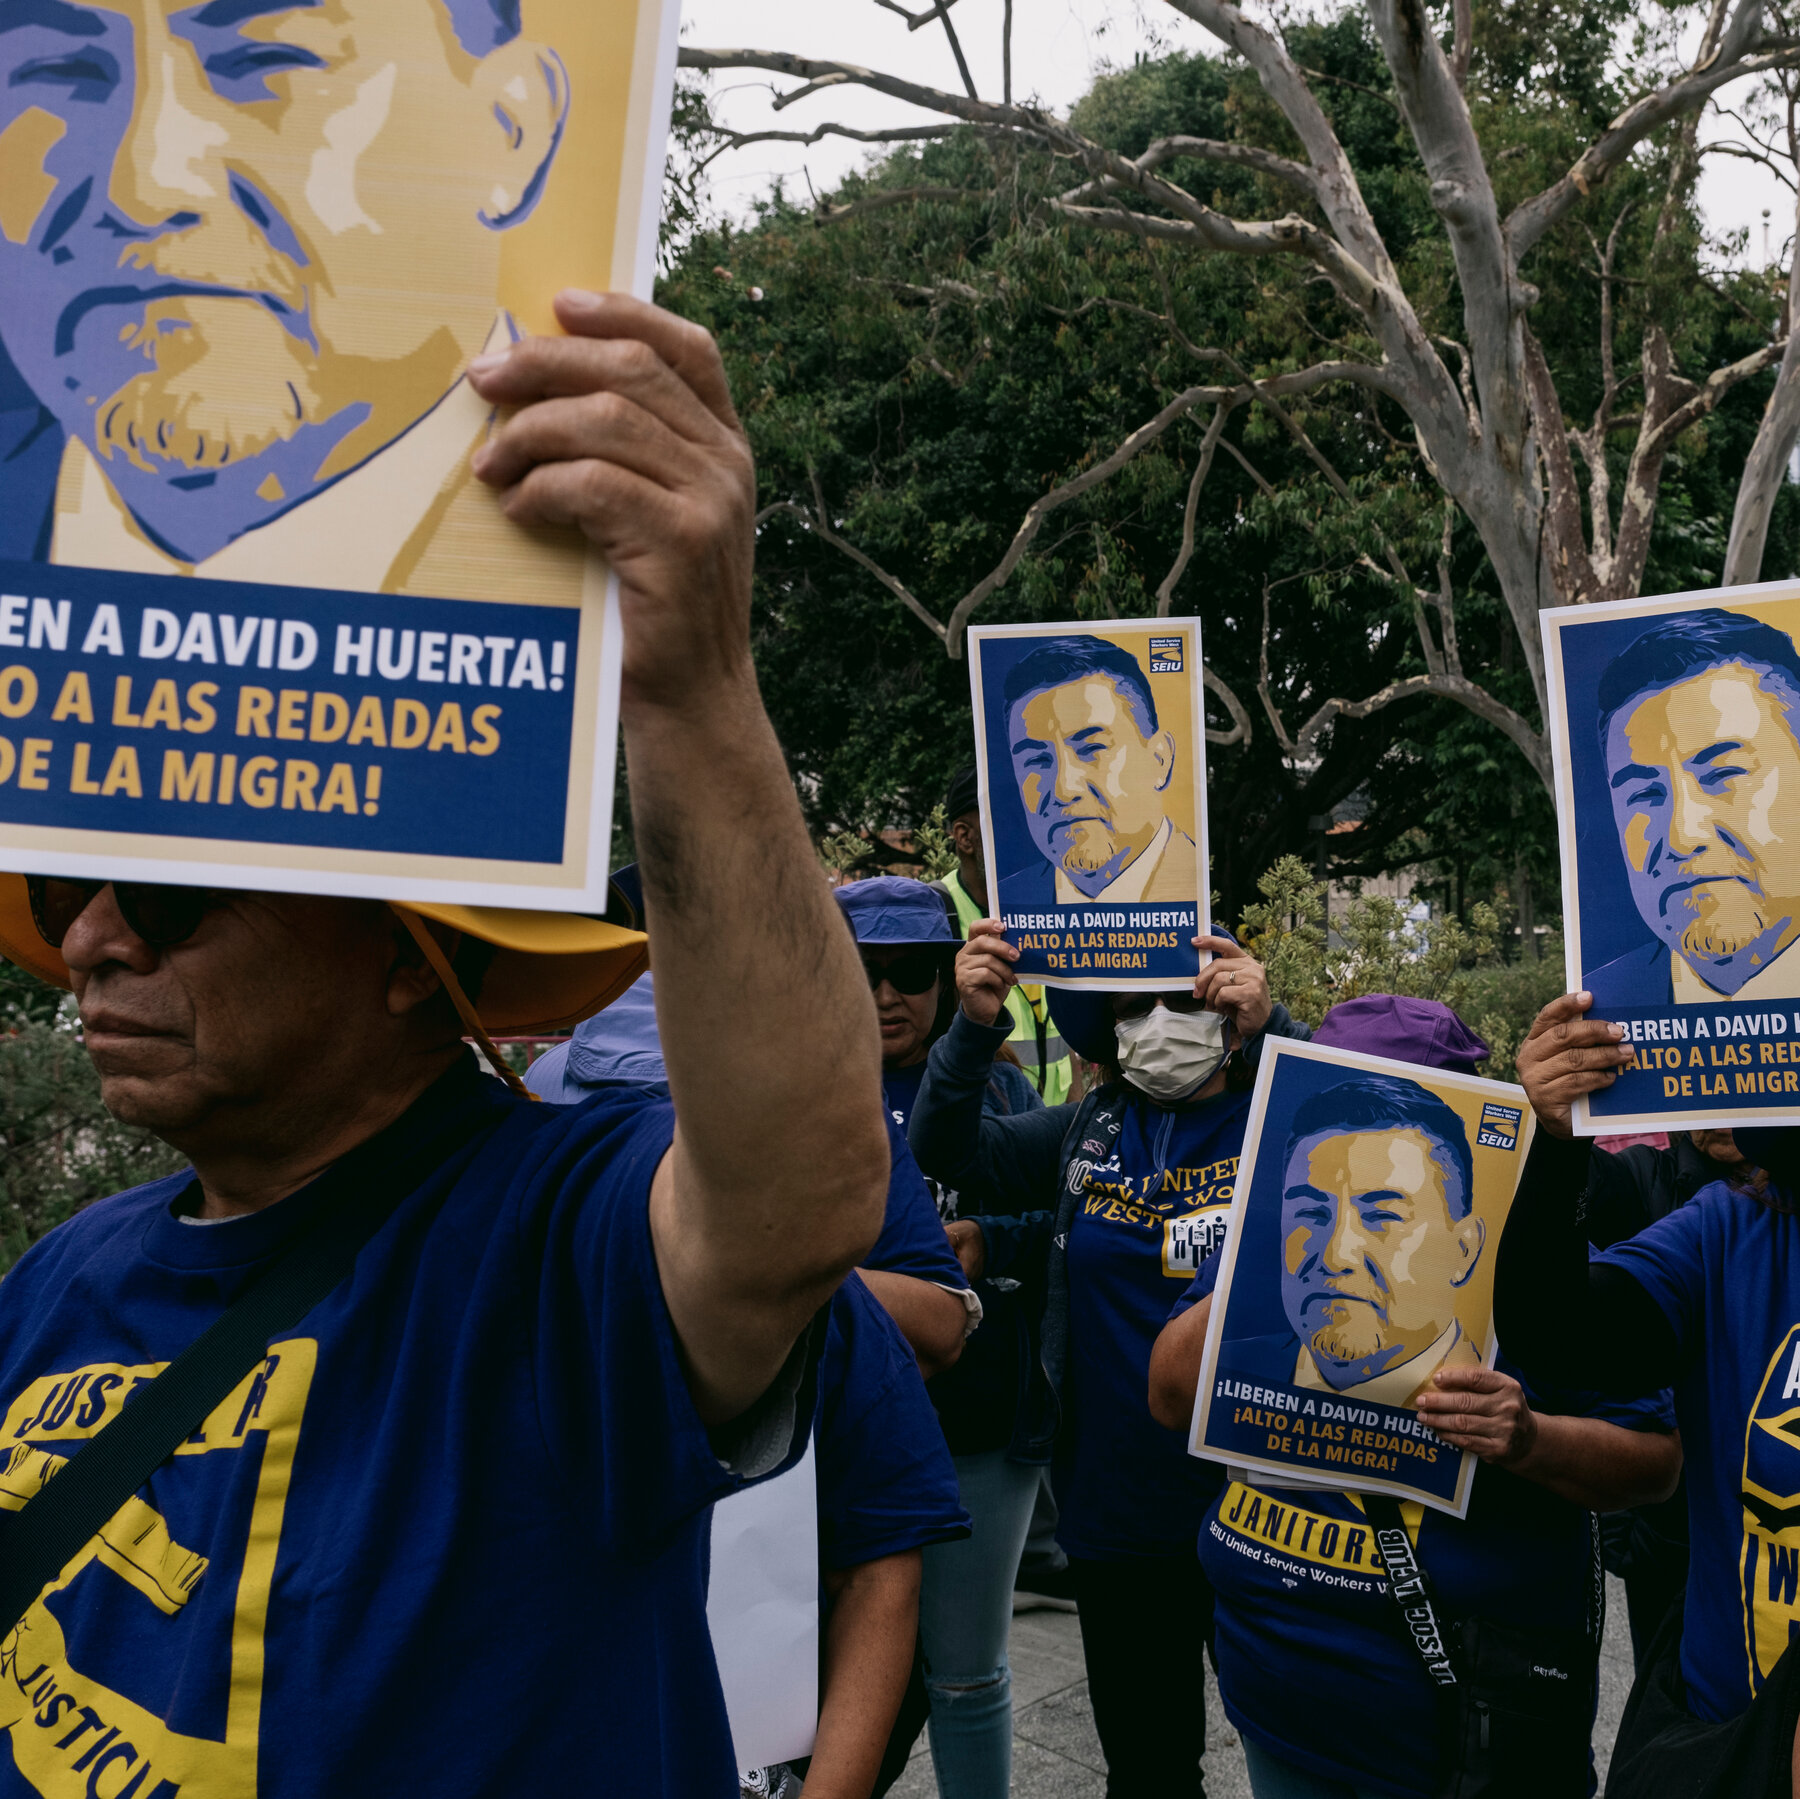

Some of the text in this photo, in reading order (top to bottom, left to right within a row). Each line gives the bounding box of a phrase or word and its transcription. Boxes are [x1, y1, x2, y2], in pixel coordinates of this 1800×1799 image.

[82, 604, 124, 656] A
[139, 607, 319, 671] DAVID
[333, 624, 567, 692] HUERTA!
[1151, 662, 1181, 672] SEIU
[51, 671, 95, 725] A
[111, 676, 220, 734] LAS
[235, 686, 502, 756] REDADAS
[69, 743, 143, 798] LA
[160, 751, 382, 817] MIGRA!
[1003, 911, 1195, 931] ¡LIBEREN A DAVID HUERTA!
[1018, 932, 1178, 952] ¡ALTO A LAS REDADAS
[1048, 952, 1147, 969] DE LA MIGRA!
[1616, 1018, 1688, 1042] BEREN
[1694, 1017, 1710, 1038] A
[1715, 1013, 1787, 1037] DAVID
[1689, 1046, 1704, 1067] A
[1710, 1044, 1752, 1066] LAS
[1664, 1076, 1693, 1098] DE
[1700, 1074, 1730, 1096] LA
[1479, 1134, 1514, 1148] SEIU
[1084, 1194, 1162, 1229] WEST
[1216, 1379, 1300, 1412] ¡LIBEREN
[1302, 1399, 1316, 1416] A
[1320, 1402, 1379, 1426] DAVID
[1234, 1406, 1438, 1463] ¡ALTO A LAS REDADAS
[1267, 1434, 1397, 1472] DE LA MIGRA!
[1209, 1520, 1226, 1542] SEIU
[1226, 1533, 1261, 1560] United
[1263, 1552, 1307, 1577] Service
[1310, 1568, 1372, 1592] Workers
